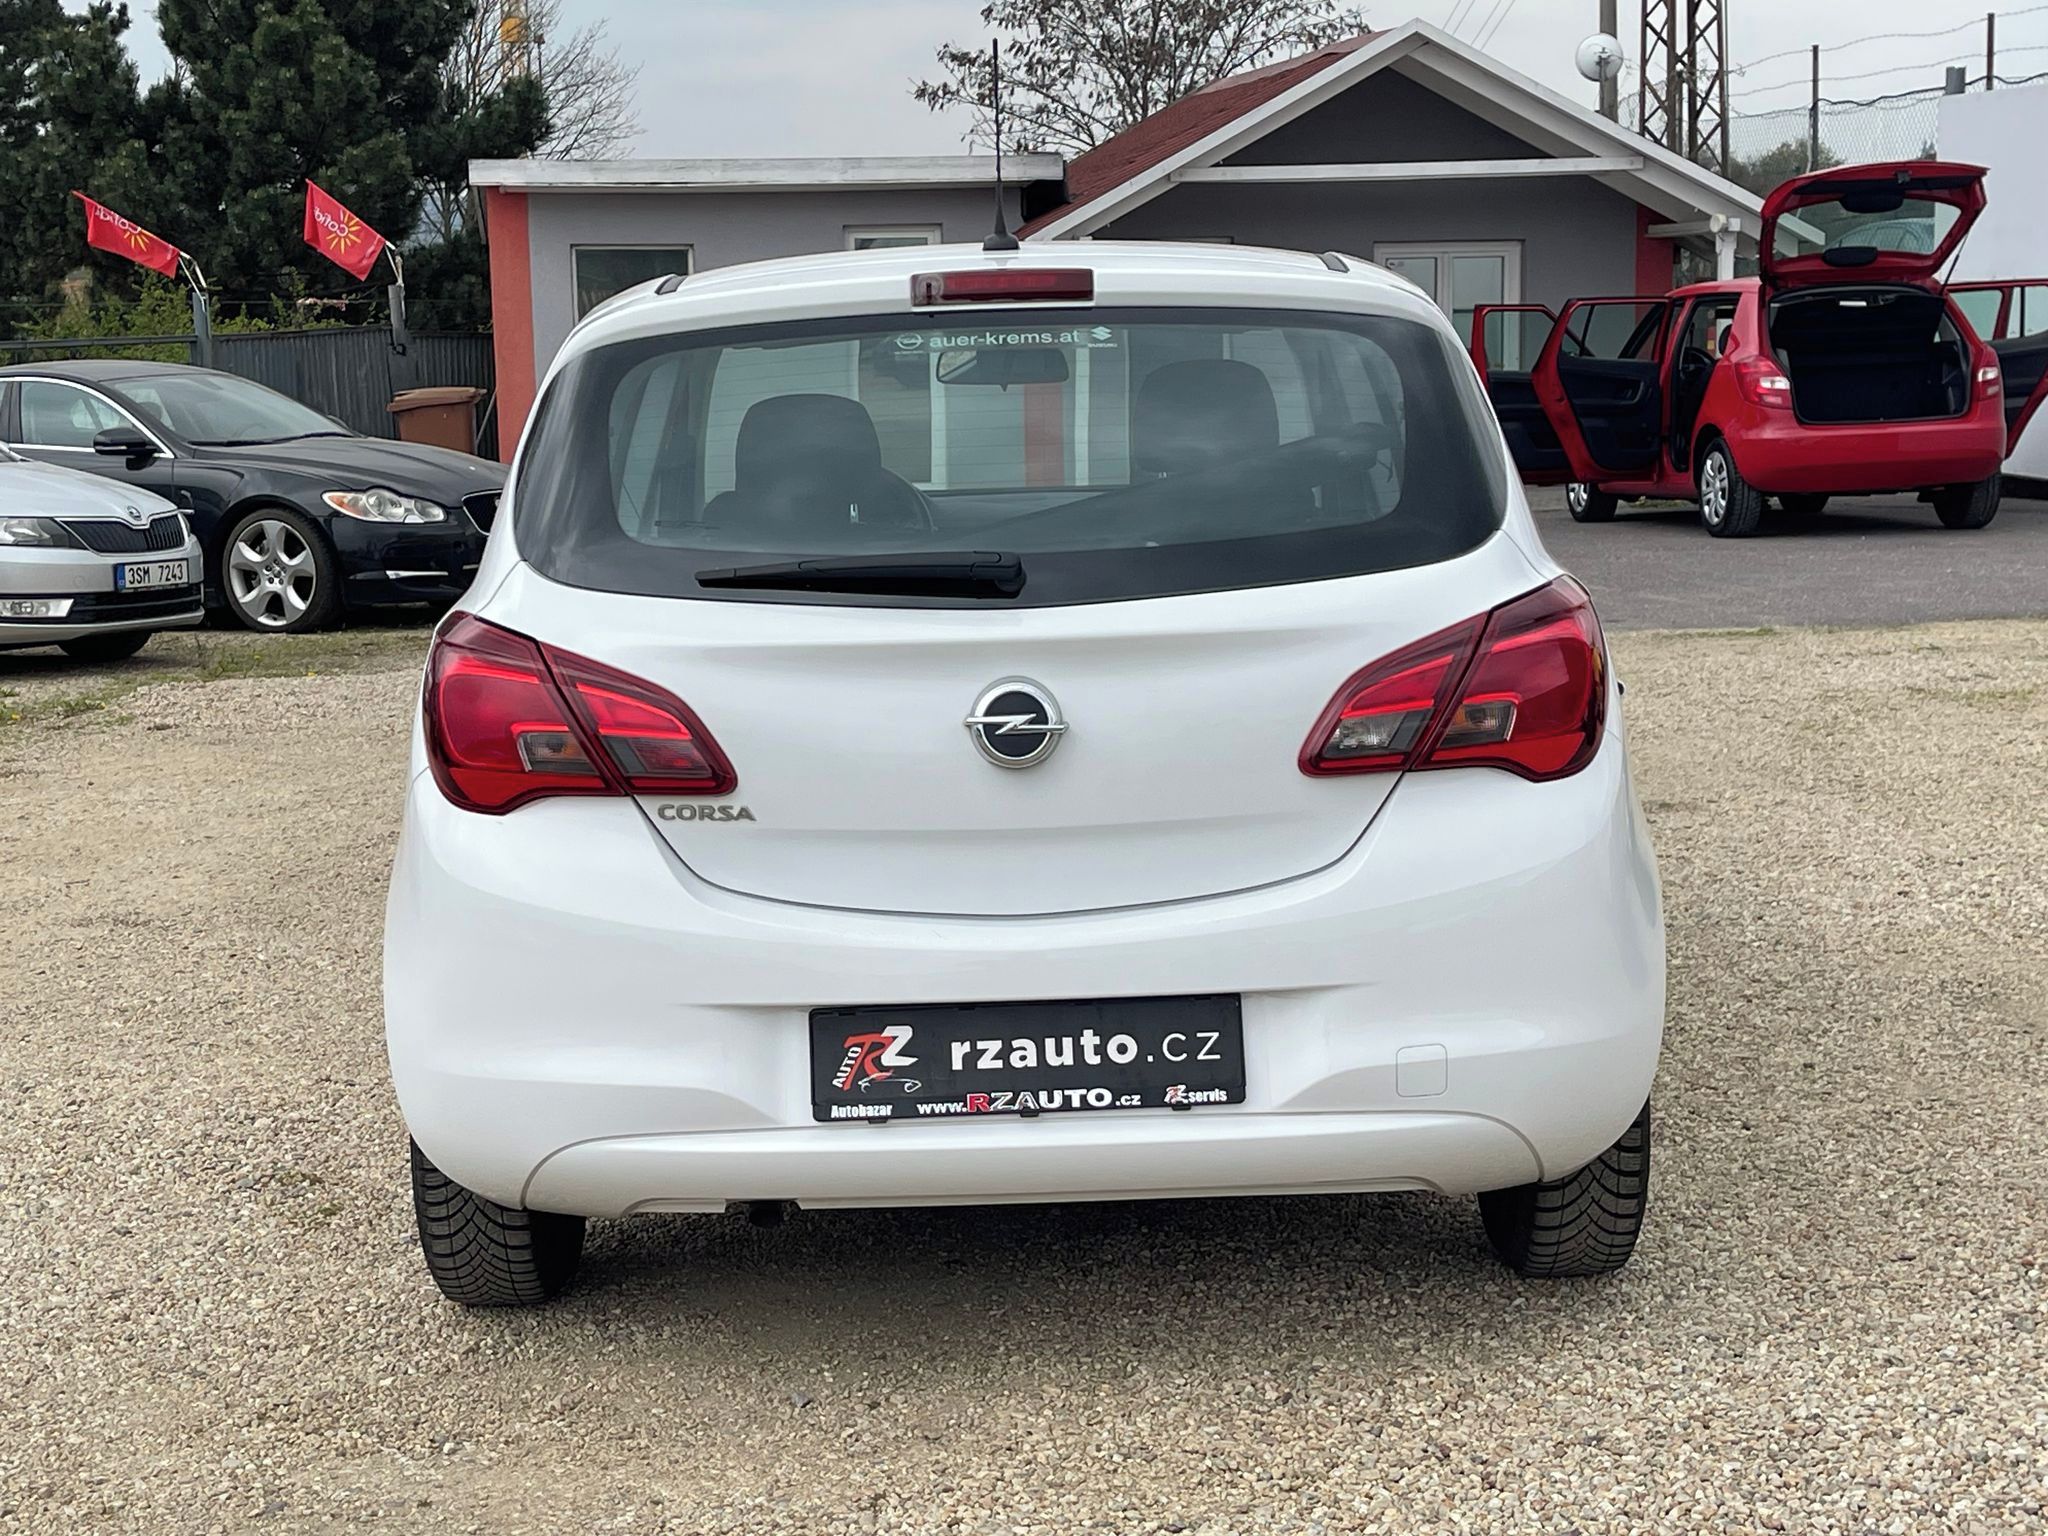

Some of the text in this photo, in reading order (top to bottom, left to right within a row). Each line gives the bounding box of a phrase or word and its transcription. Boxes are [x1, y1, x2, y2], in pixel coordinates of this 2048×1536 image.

[929, 330, 1081, 348] auer-krems.at
[128, 563, 184, 585] 3SM 7243
[657, 804, 757, 822] CORSA
[950, 1028, 1221, 1071] rzauto.cz
[831, 1046, 862, 1089] AUTO
[830, 1103, 893, 1119] Autobazar
[916, 1087, 1141, 1115] www.RZAUTO.cz
